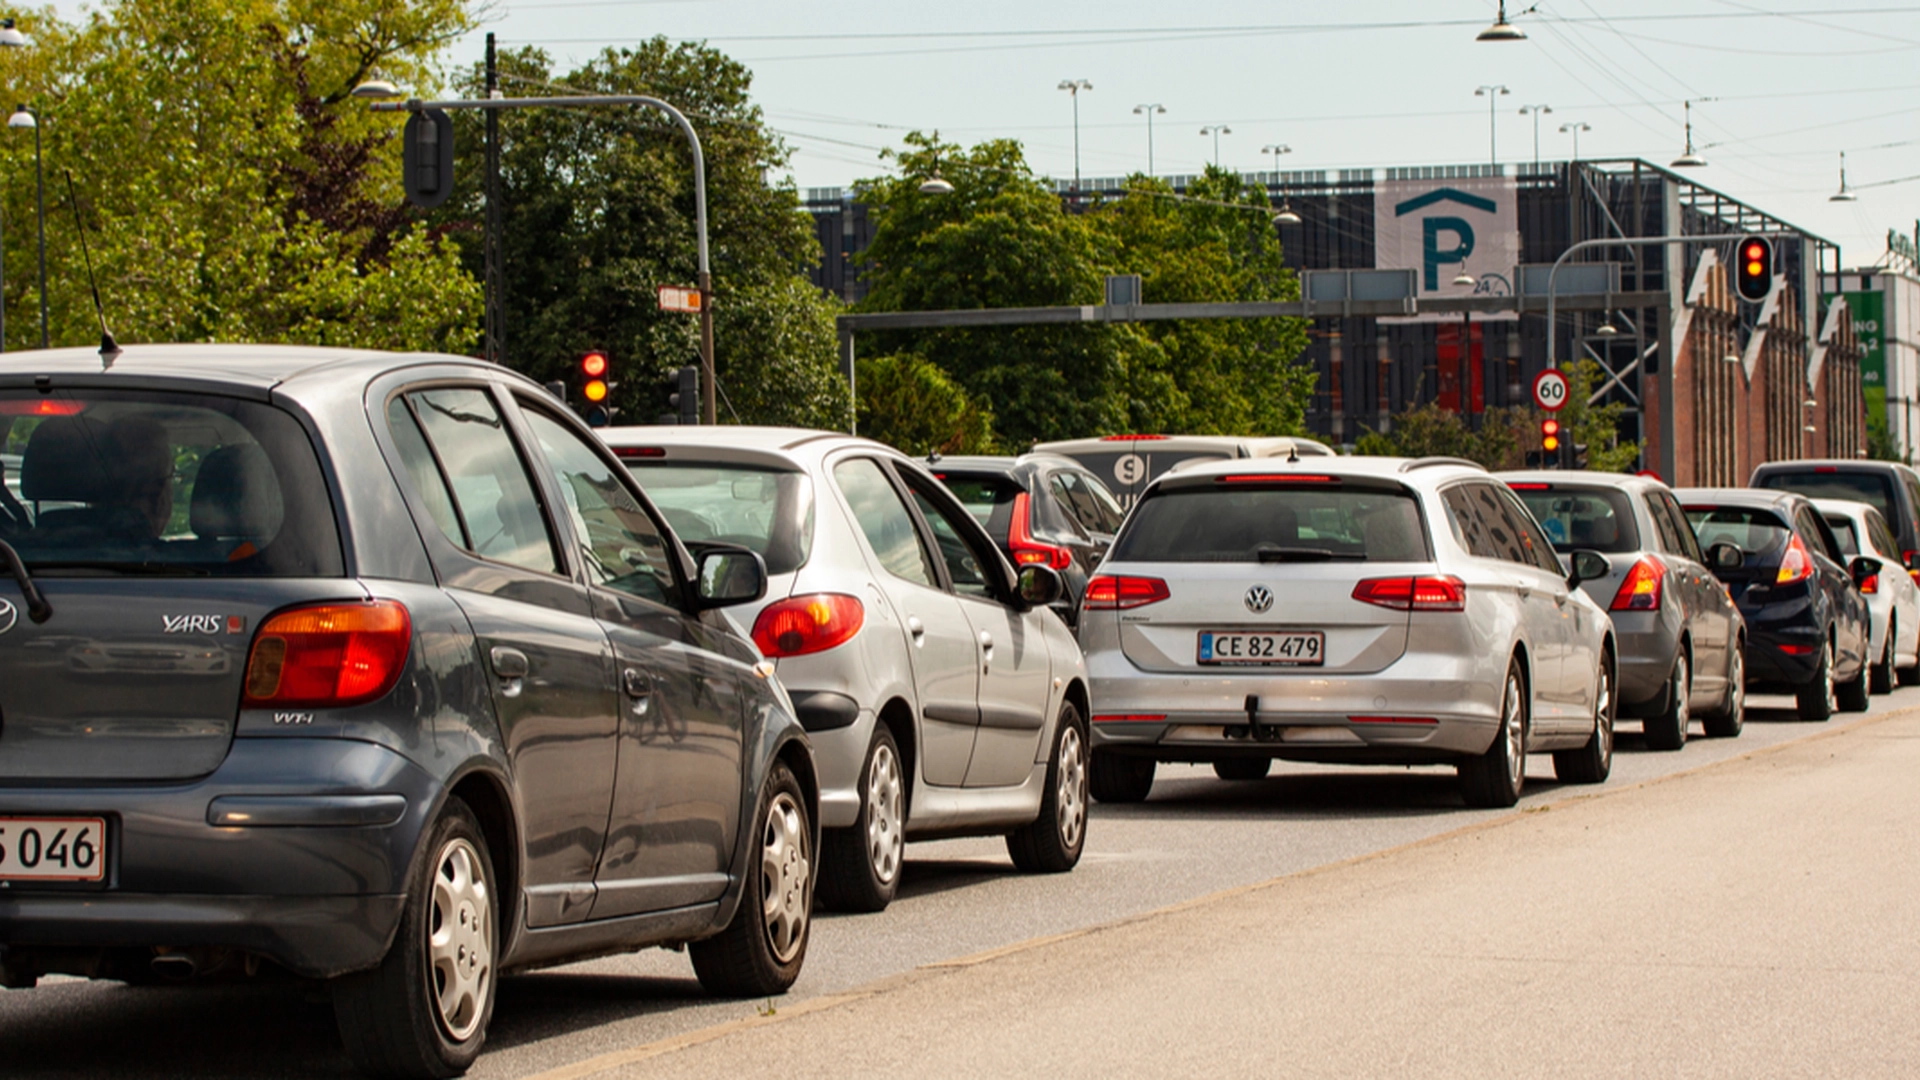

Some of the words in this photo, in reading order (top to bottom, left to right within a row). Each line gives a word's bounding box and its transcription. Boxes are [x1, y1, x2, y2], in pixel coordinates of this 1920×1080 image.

[1422, 216, 1475, 291] P
[1540, 381, 1564, 399] 60
[162, 614, 222, 634] YARIS
[1215, 636, 1242, 656] CE
[1248, 636, 1274, 657] 82
[1280, 636, 1319, 657] 479
[18, 827, 95, 869] 046
